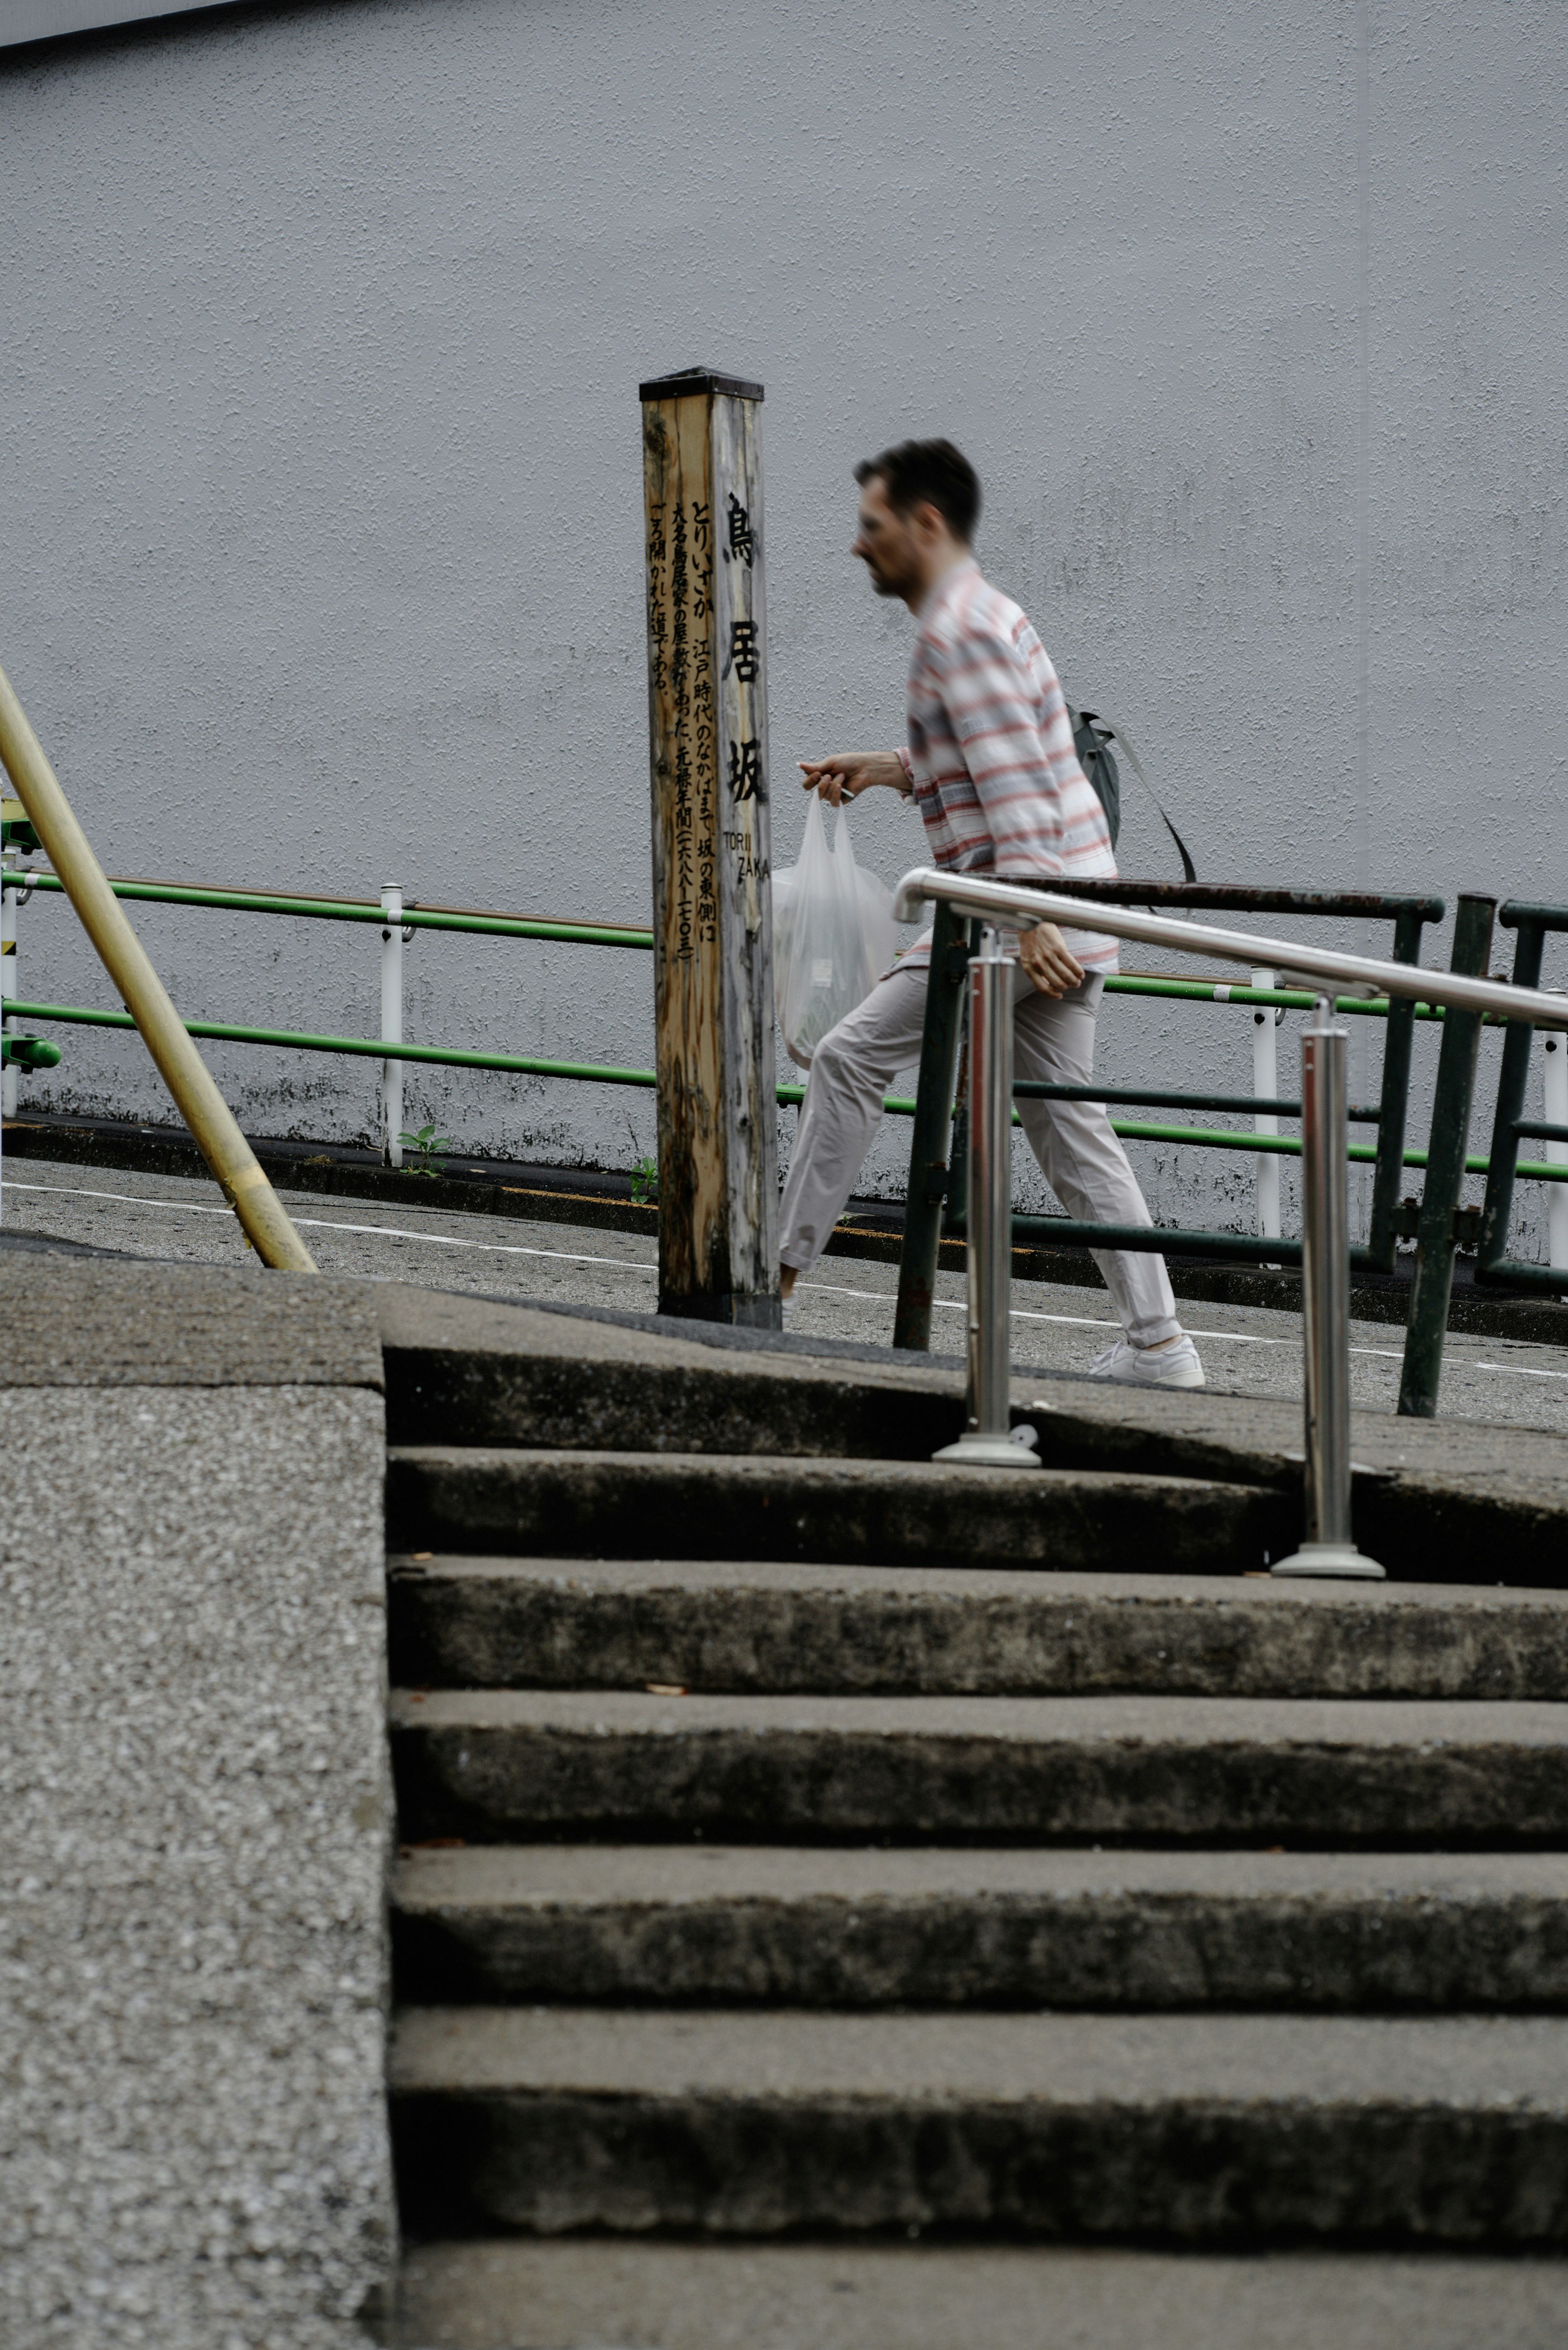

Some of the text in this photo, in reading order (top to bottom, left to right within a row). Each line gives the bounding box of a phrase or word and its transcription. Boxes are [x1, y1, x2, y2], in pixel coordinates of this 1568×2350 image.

[722, 492, 768, 803] 鳥居坂
[723, 831, 751, 852] TORII
[737, 856, 770, 879] ZAKA
